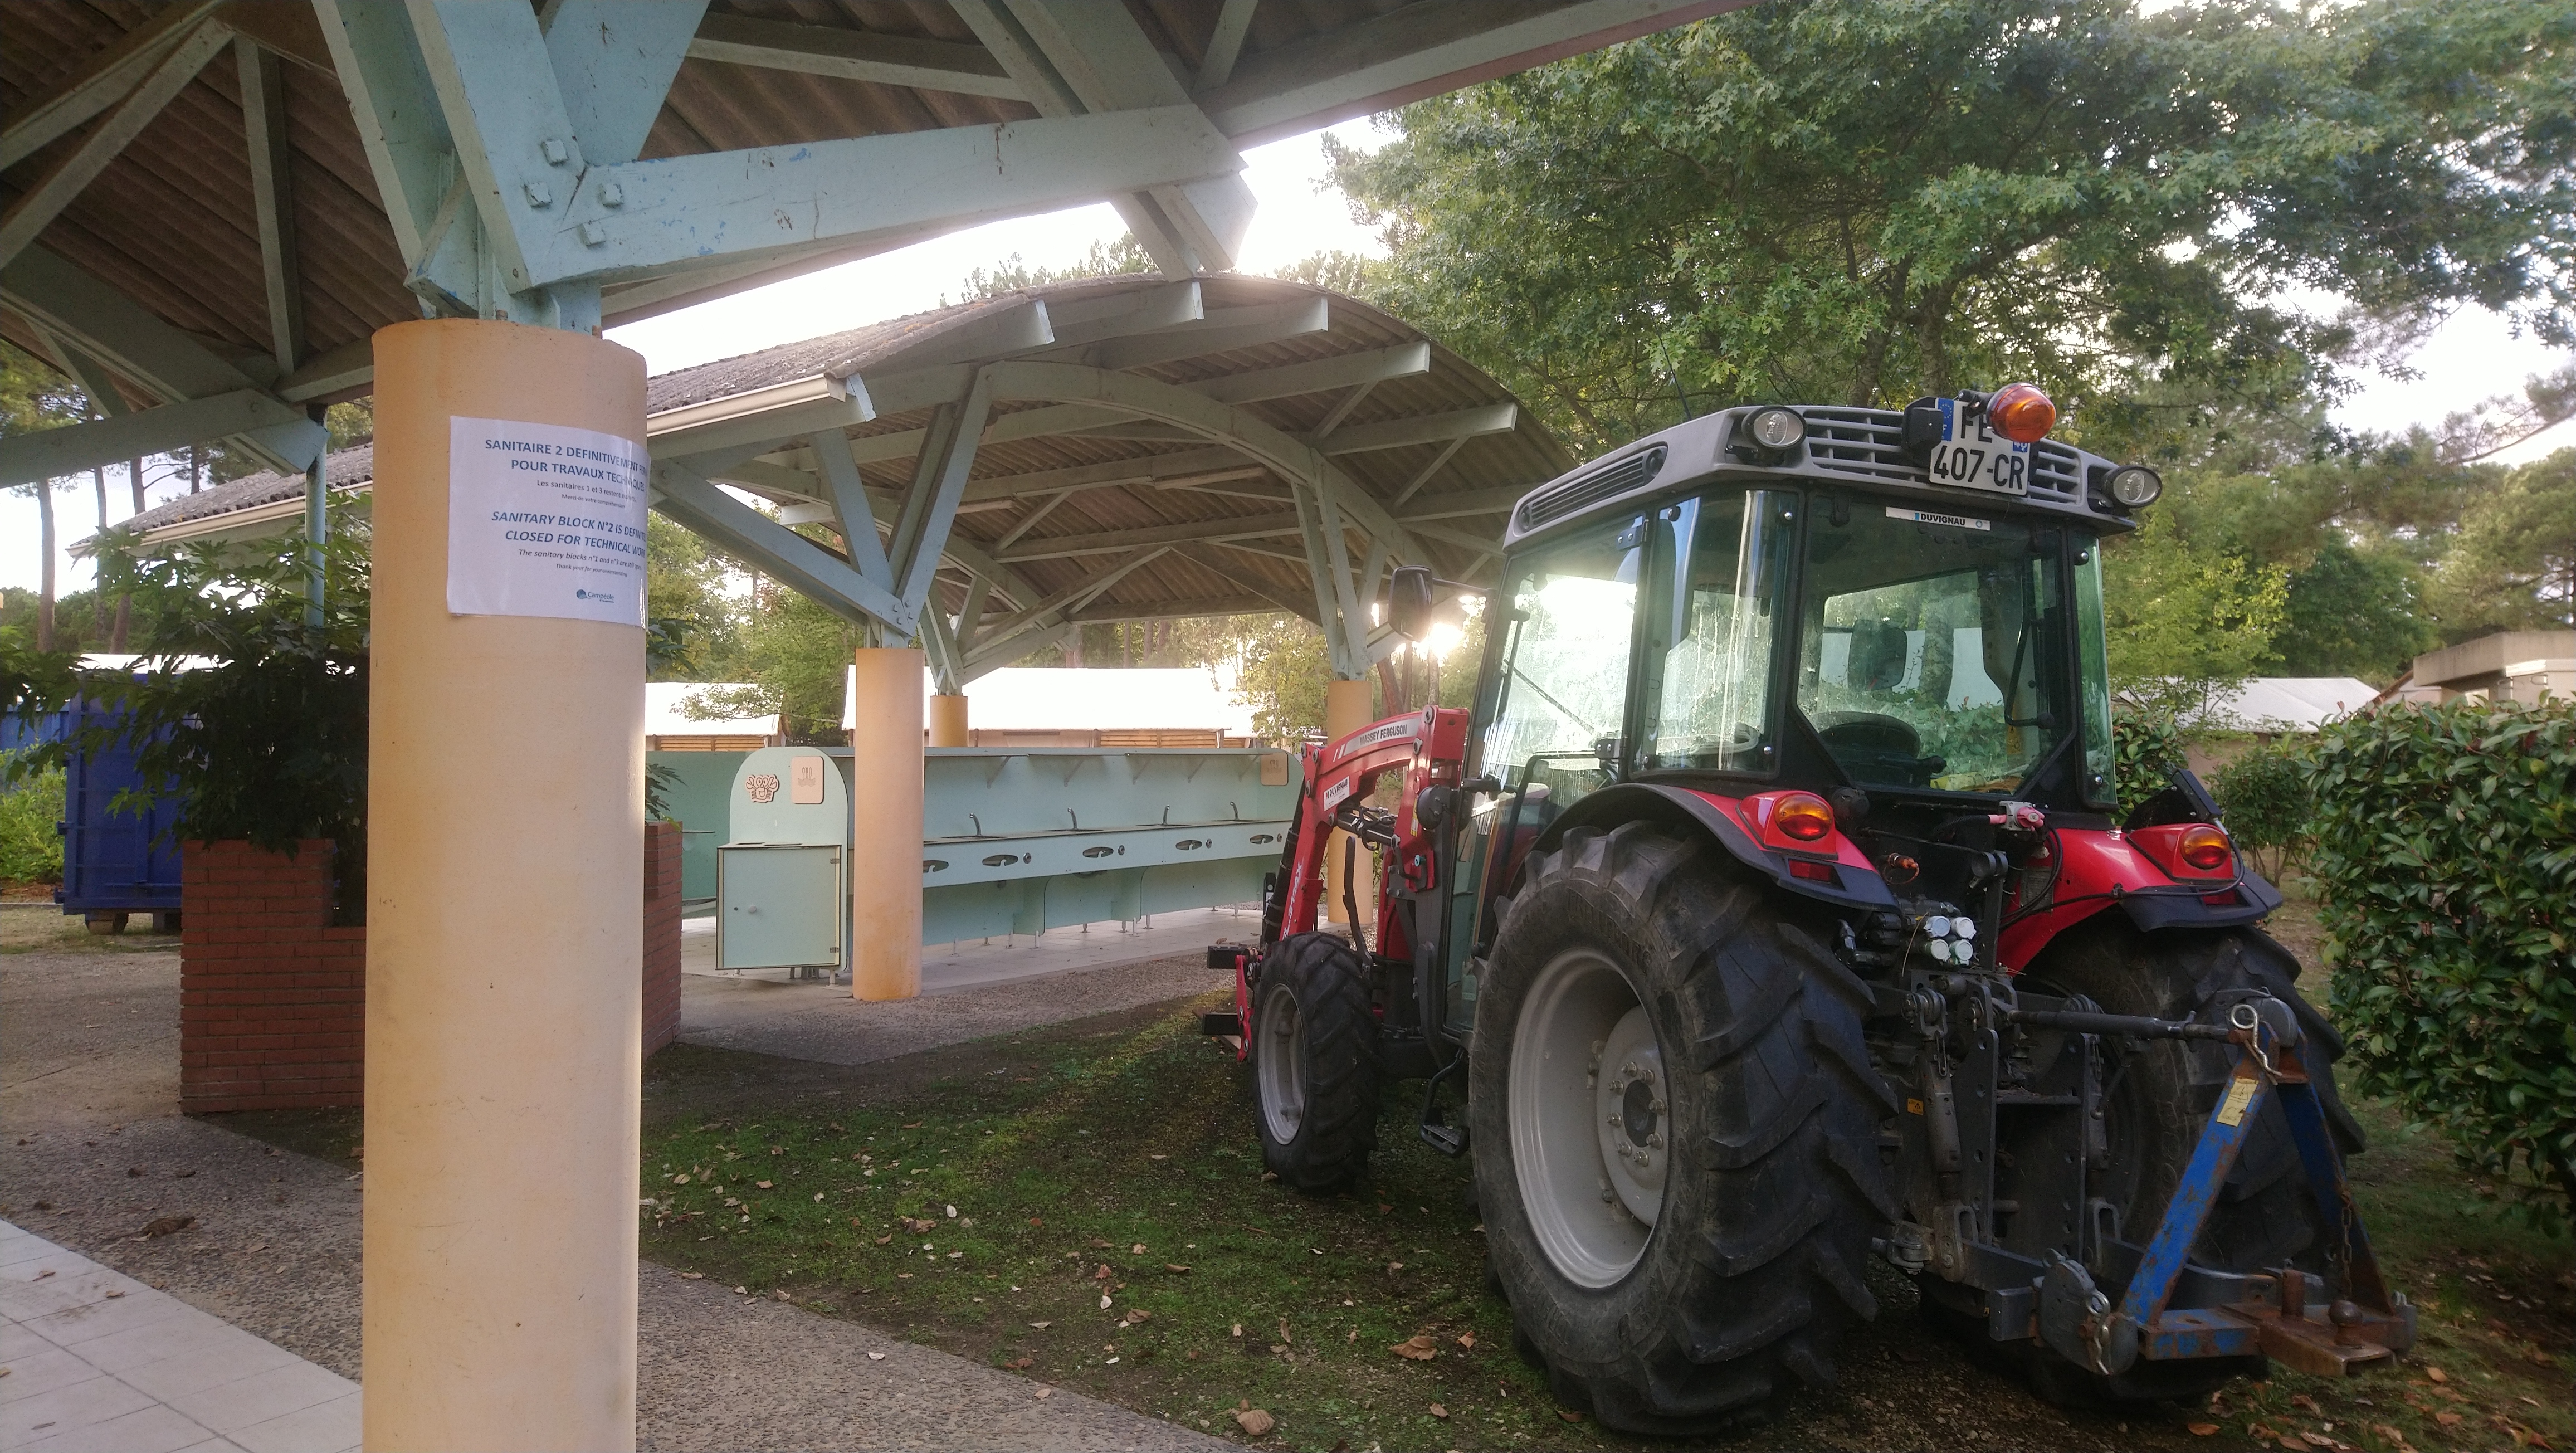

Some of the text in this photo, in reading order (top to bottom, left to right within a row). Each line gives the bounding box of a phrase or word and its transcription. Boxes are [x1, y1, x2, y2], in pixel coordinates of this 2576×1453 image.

[485, 440, 552, 455] SANITAIRE
[555, 446, 562, 456] 2
[567, 447, 638, 472] DEFINITIVEMENT
[511, 460, 548, 472] POUR
[552, 463, 604, 480] TRAVAUX
[1934, 445, 2024, 490] 407-CR
[551, 482, 584, 491] sanitaires
[491, 511, 555, 524] SANITARY
[558, 516, 595, 529] BLOCK
[597, 521, 613, 533] N°2
[615, 524, 622, 534] IS
[1921, 513, 1965, 526] DUVIGNAU
[505, 530, 553, 543] CLOSED
[557, 534, 581, 545] FOR
[585, 537, 630, 553] TECHNICAL
[534, 550, 564, 560] sanitary
[566, 552, 587, 560] blocks
[1359, 724, 1407, 745] MASSEY FERGUSON
[1330, 779, 1348, 796] DUVIGNAU
